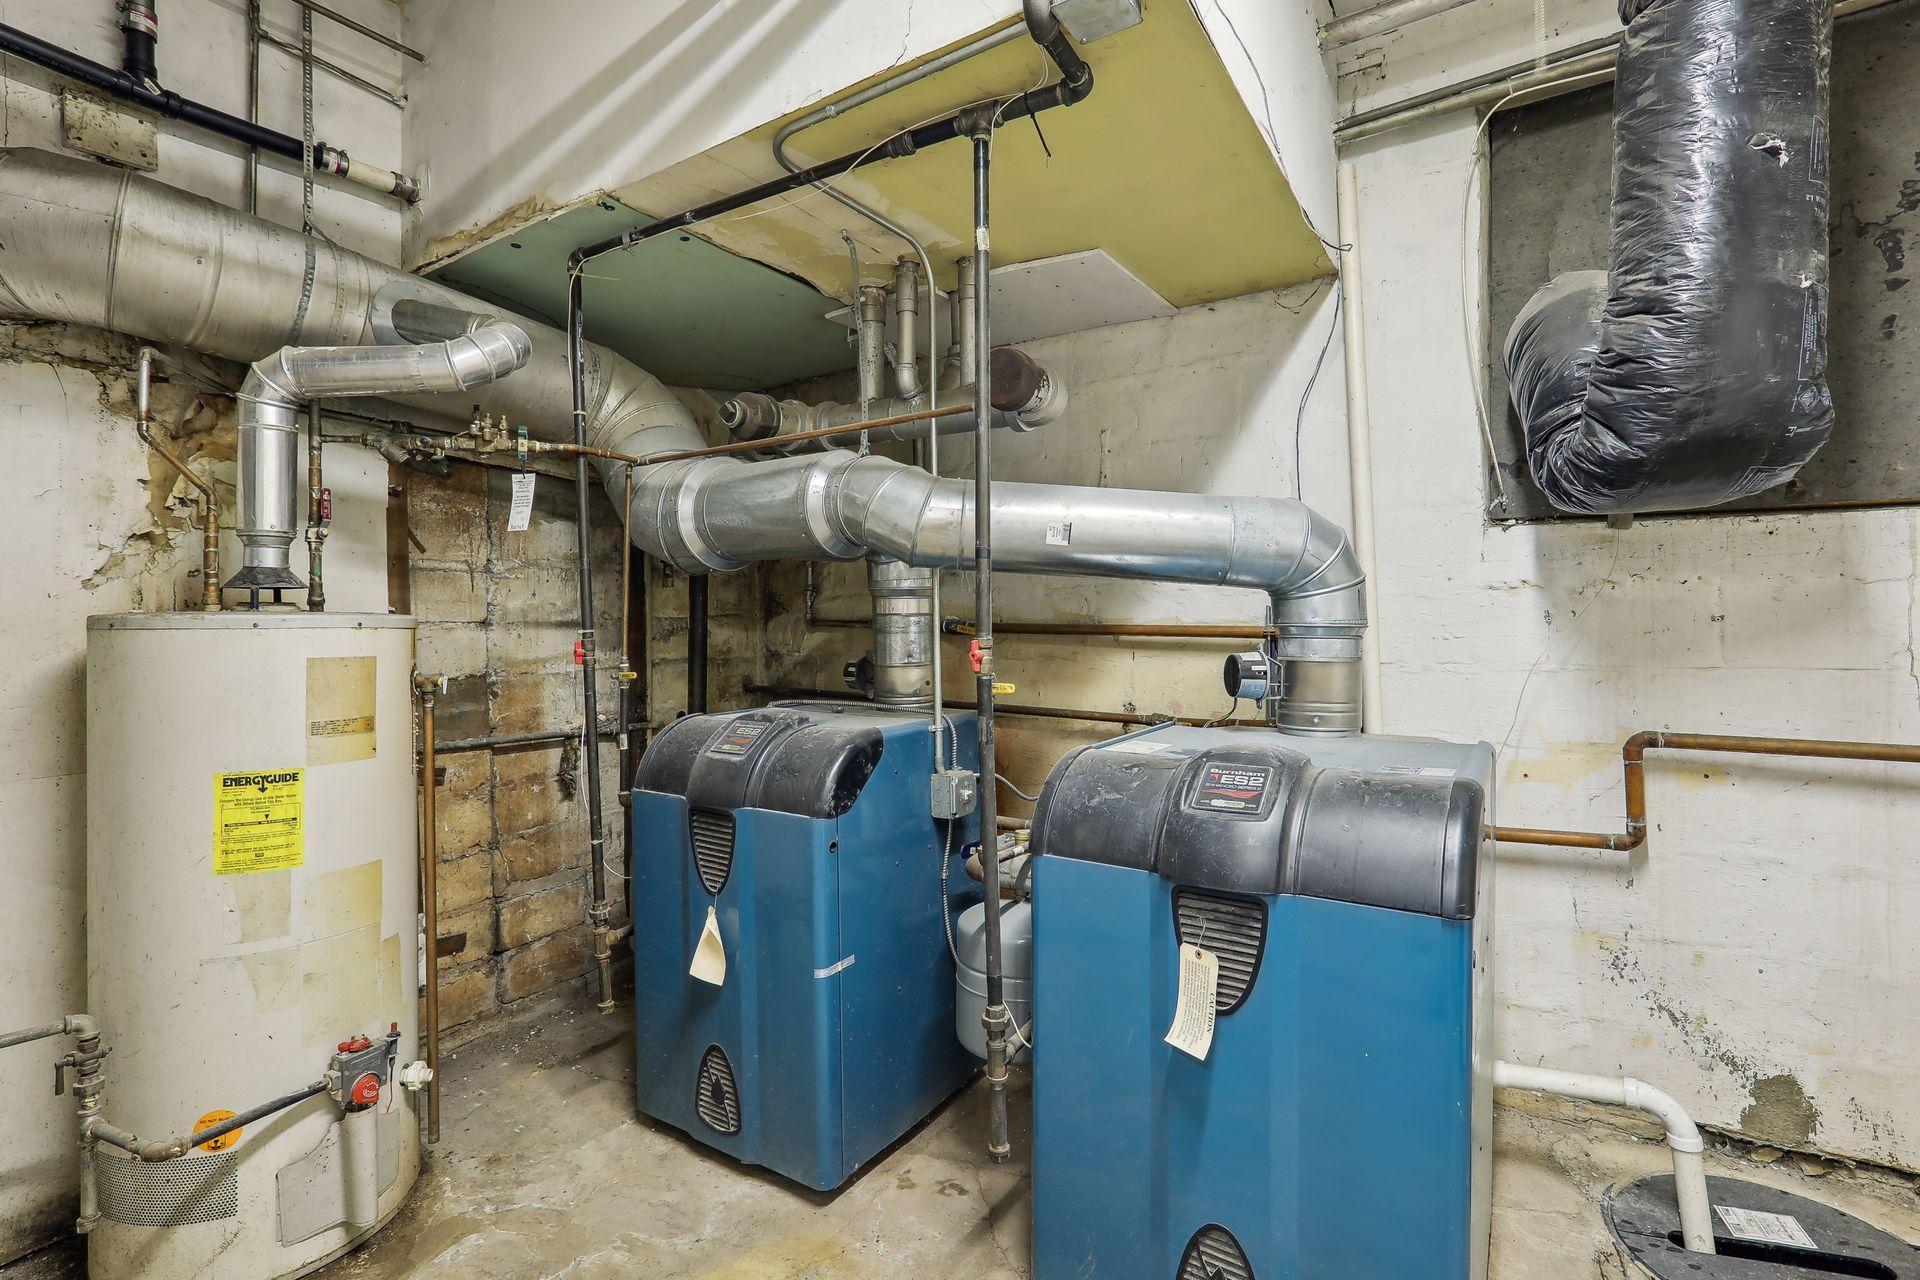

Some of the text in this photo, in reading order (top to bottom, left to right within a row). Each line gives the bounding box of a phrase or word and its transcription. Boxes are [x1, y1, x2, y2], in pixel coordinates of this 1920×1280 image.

[1210, 768, 1265, 777] Burnham
[222, 772, 299, 788] ENERGYGUIDE
[1220, 774, 1264, 787] ES2
[1206, 992, 1216, 1033] CAUTION
